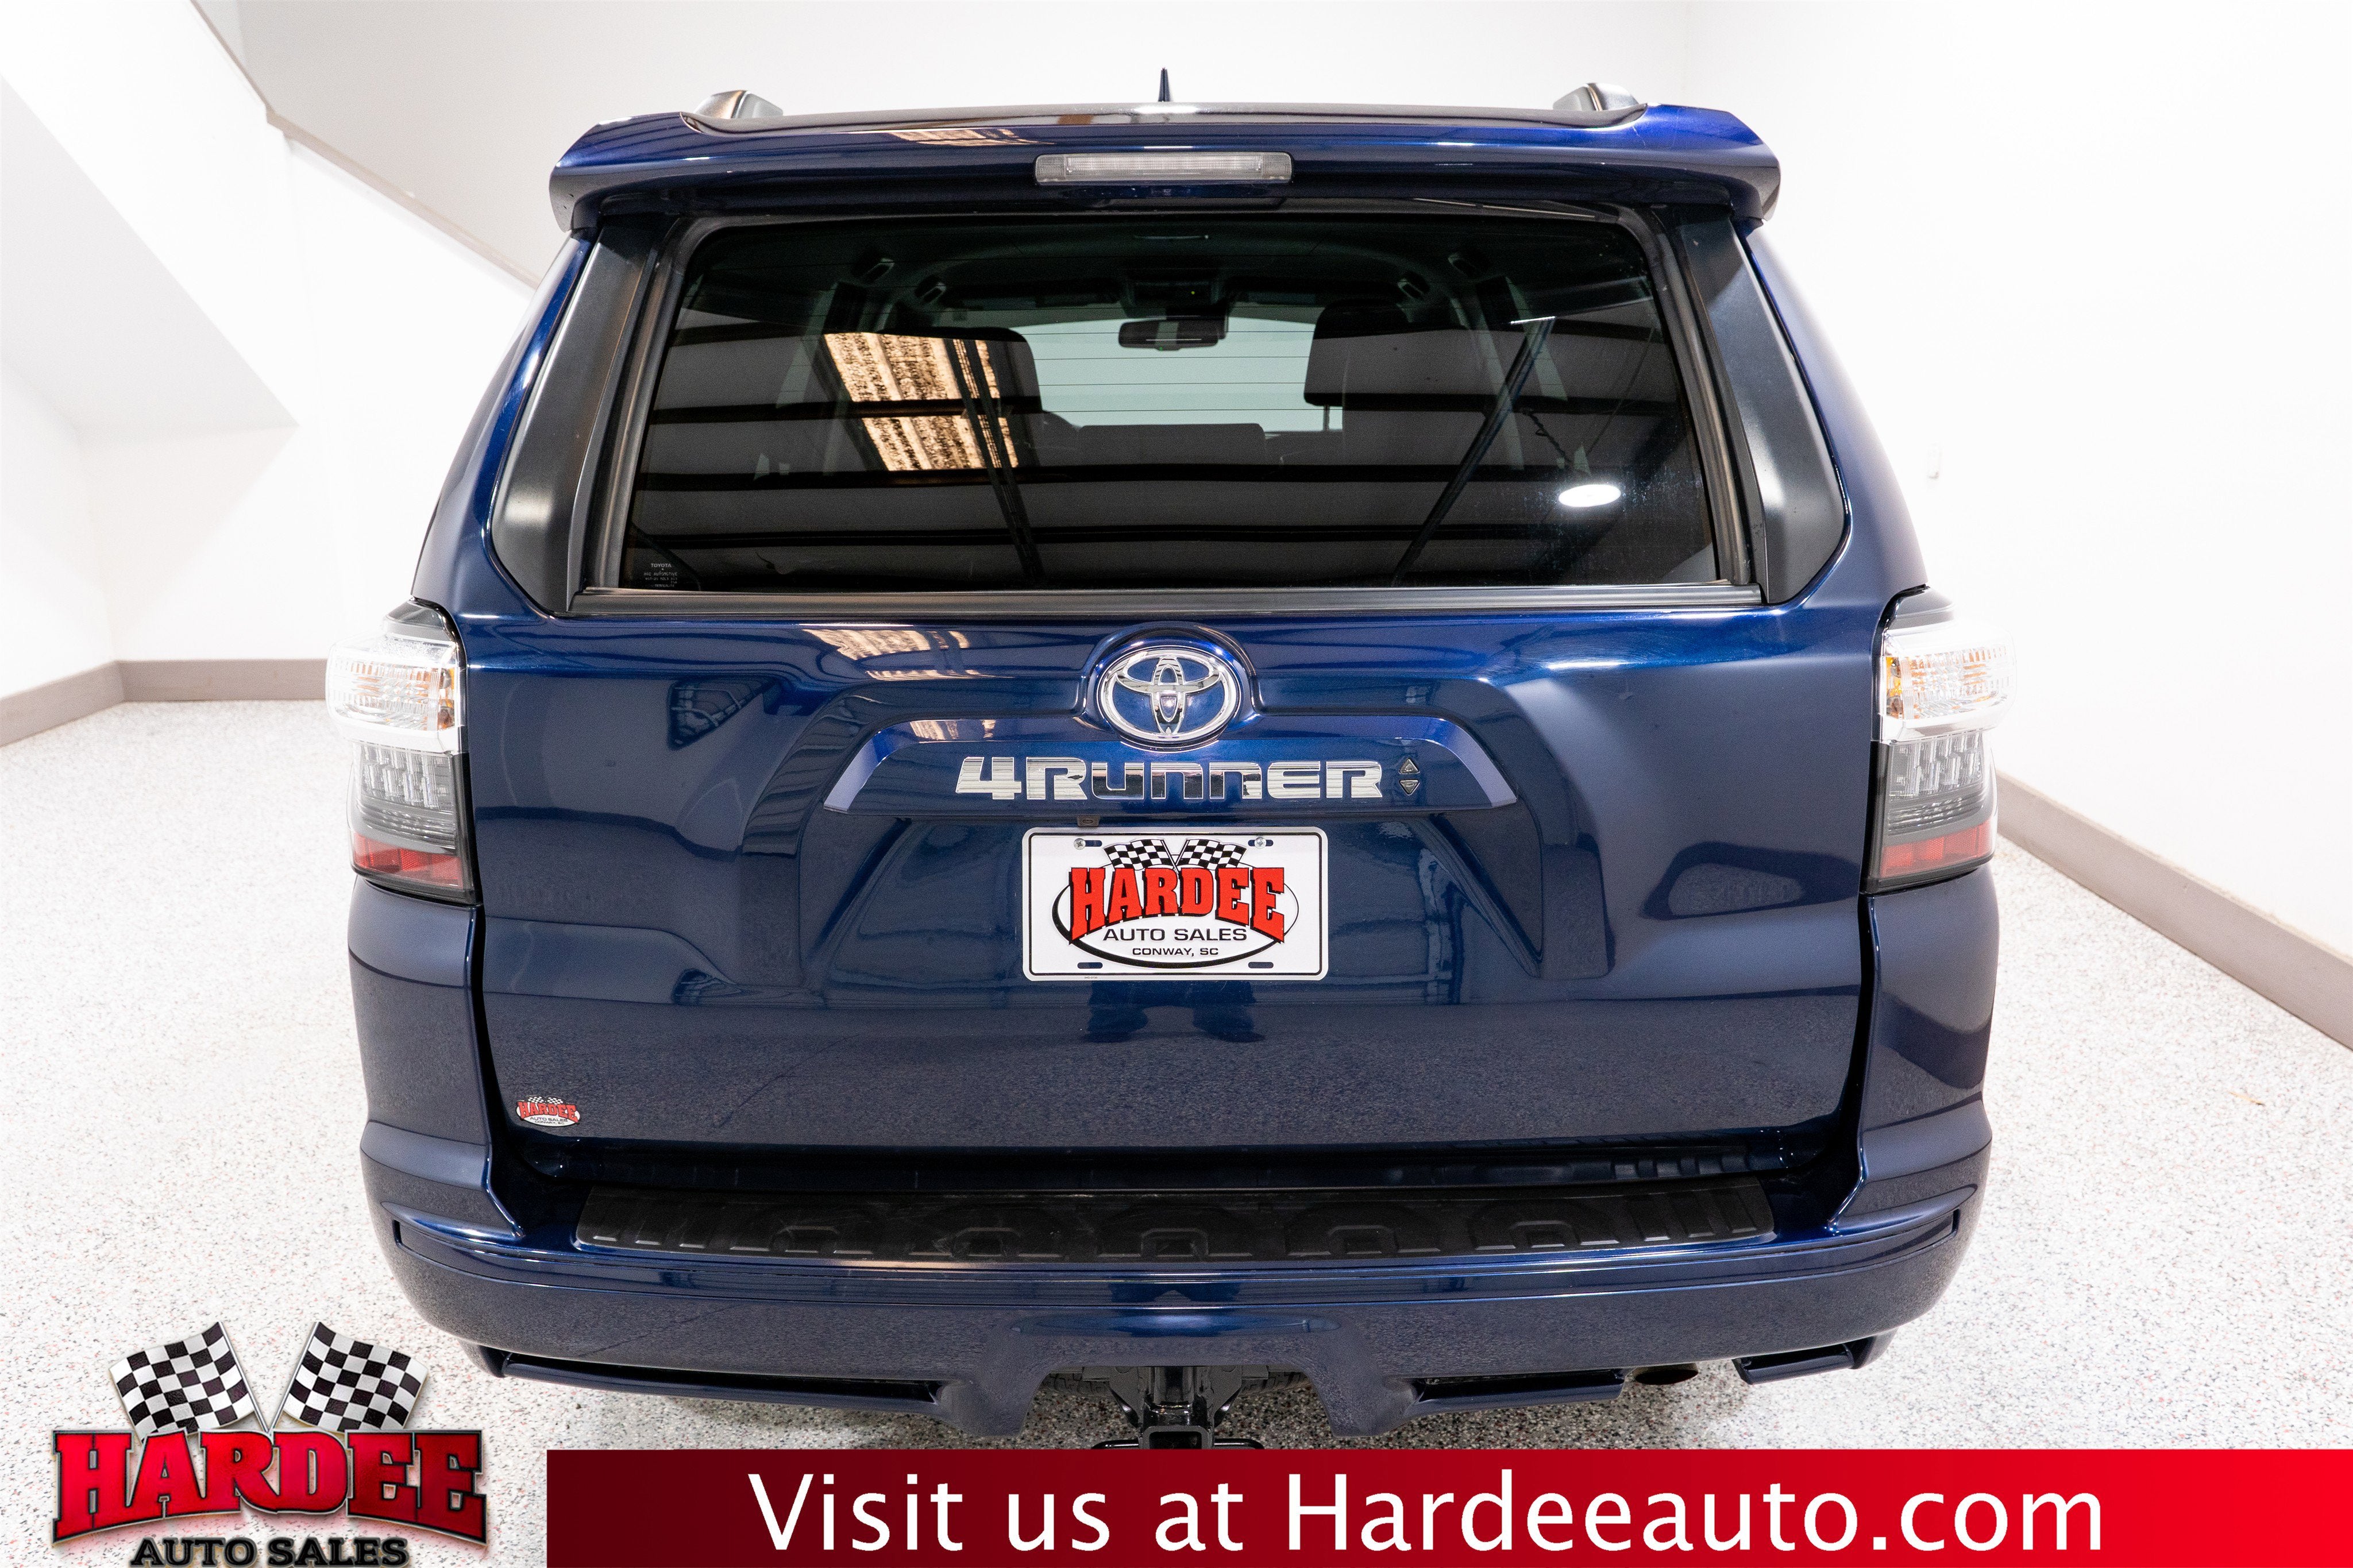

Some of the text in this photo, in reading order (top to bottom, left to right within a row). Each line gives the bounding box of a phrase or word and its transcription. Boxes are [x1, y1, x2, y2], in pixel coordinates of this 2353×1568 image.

[1069, 867, 1285, 944] HARDEE
[1103, 928, 1247, 941] AUTO SALES
[1132, 948, 1194, 957] CONWAY,
[518, 1101, 578, 1123] HARDEE
